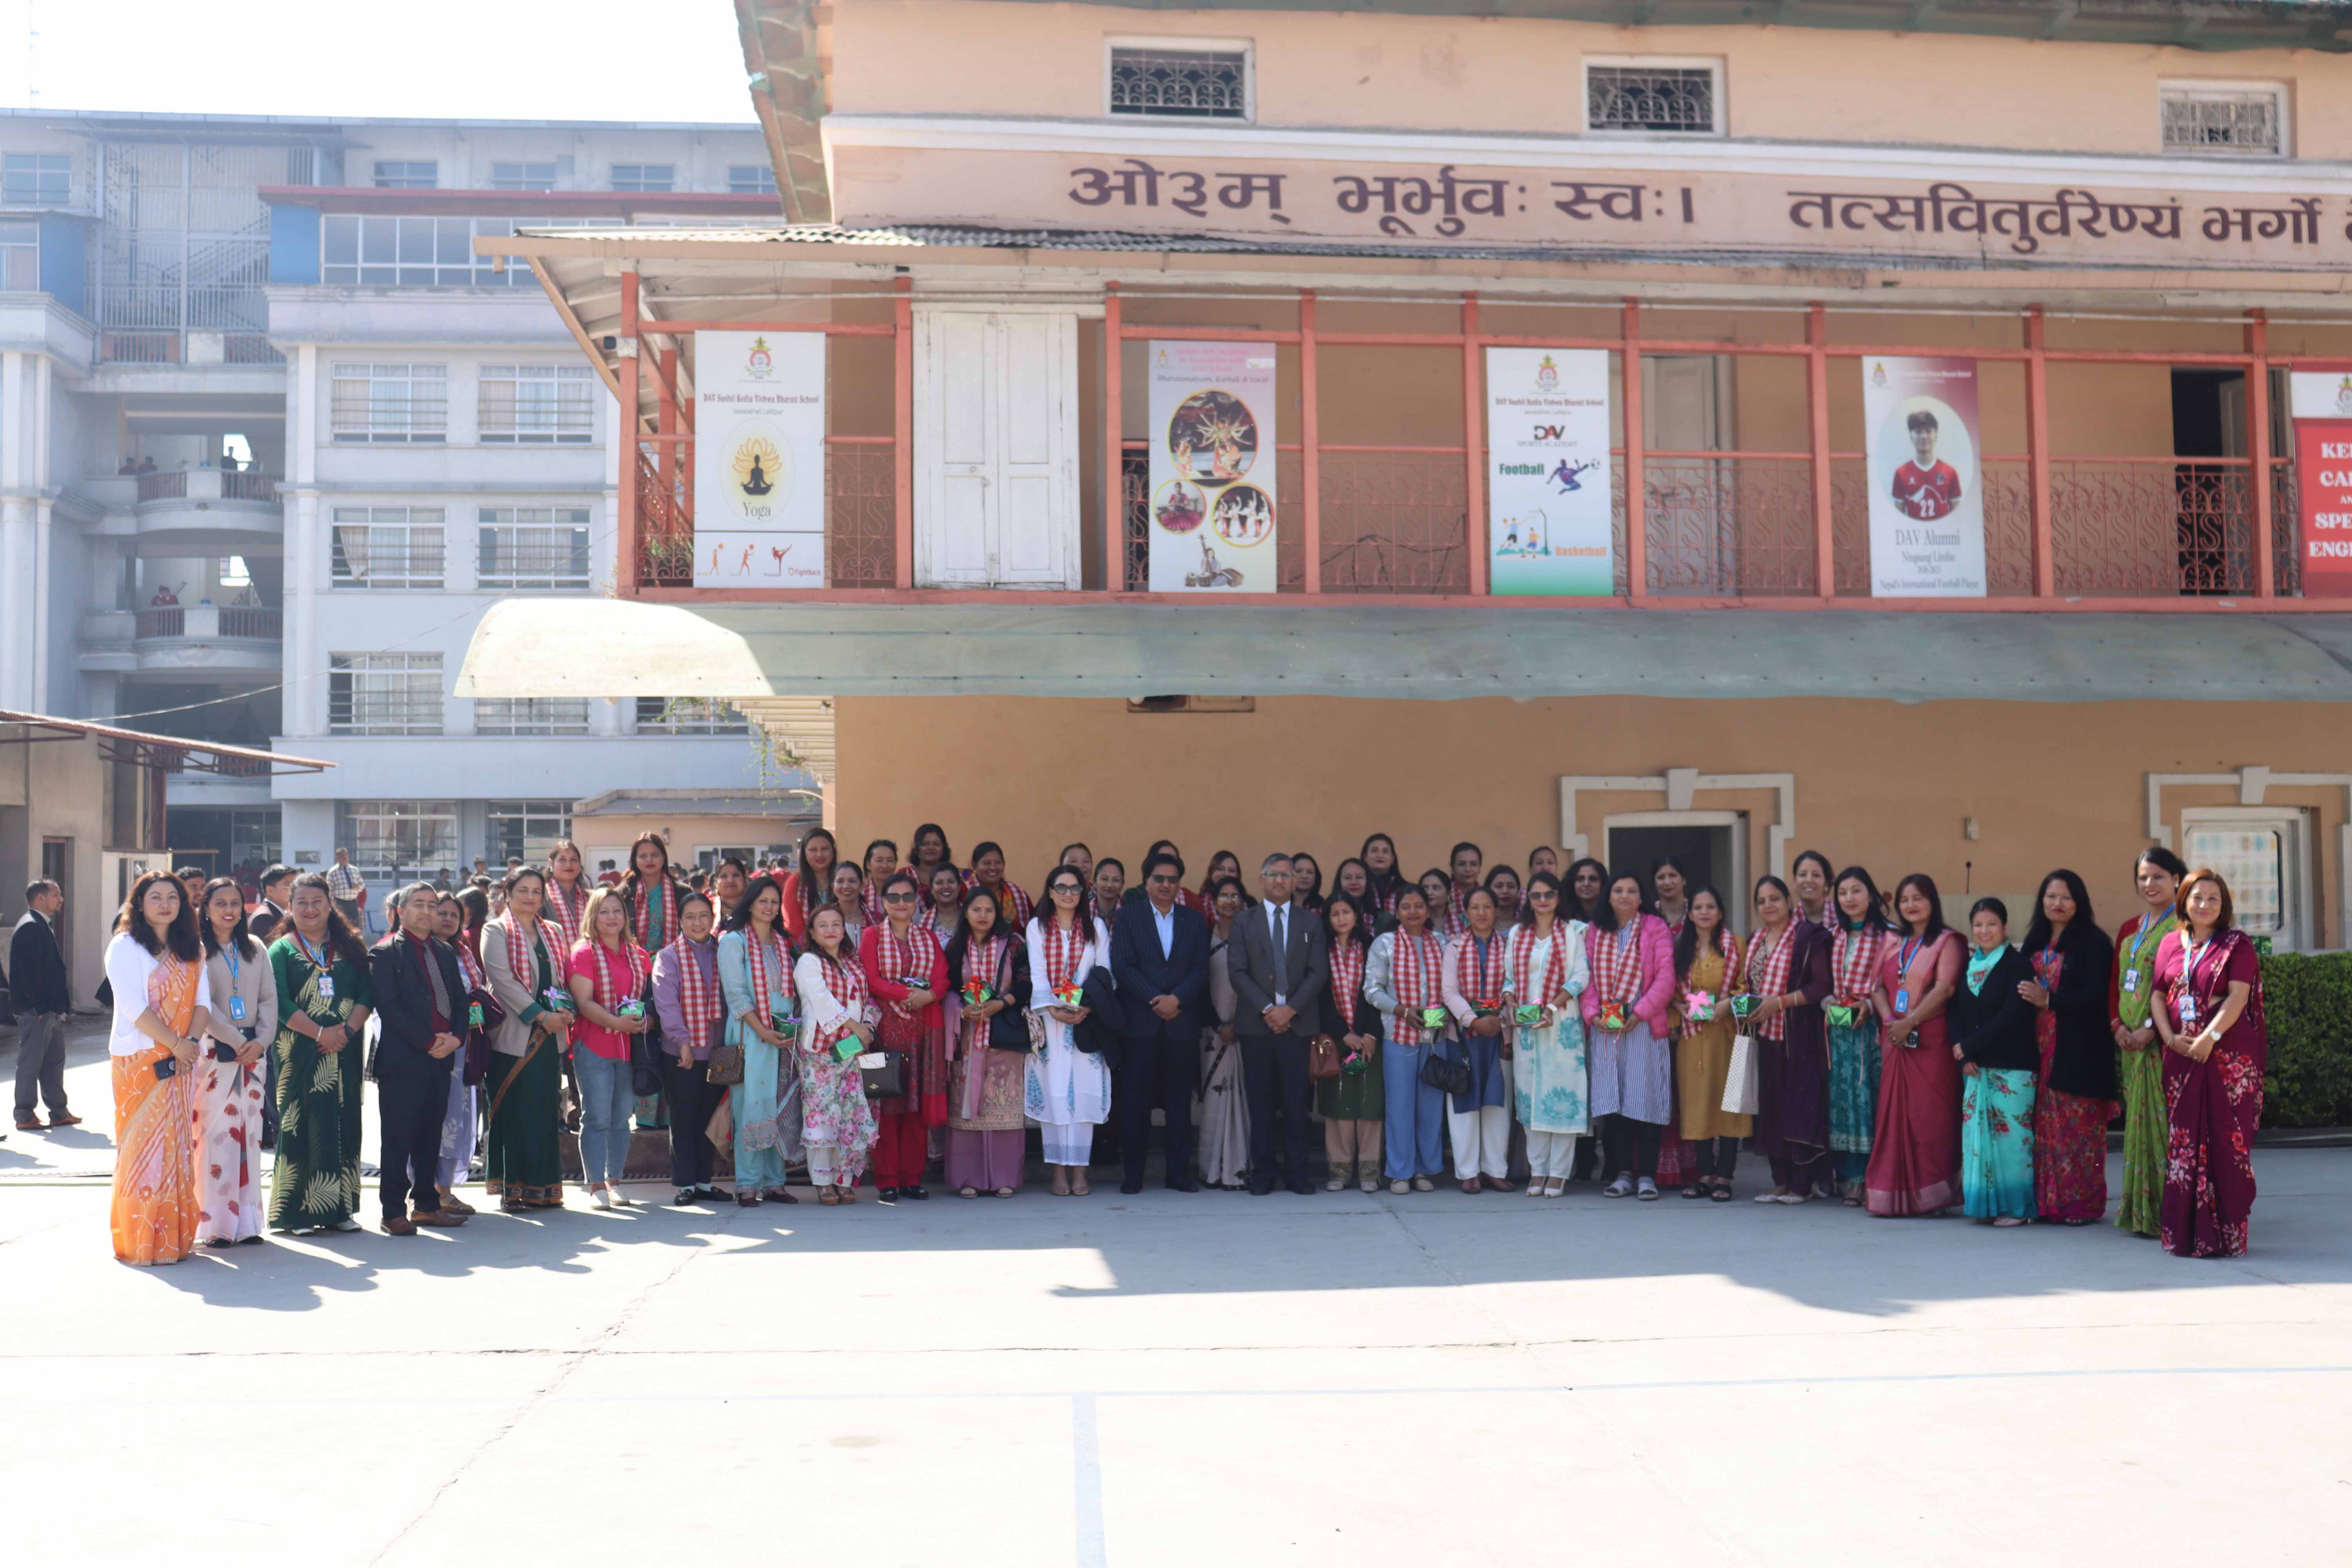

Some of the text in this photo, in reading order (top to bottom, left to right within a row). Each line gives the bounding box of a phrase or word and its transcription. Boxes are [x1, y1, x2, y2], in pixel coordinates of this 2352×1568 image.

[1069, 160, 1291, 225] ओ३म्
[1334, 165, 1527, 237] भूर्भुवः
[1788, 183, 2183, 254] तत्सवितुर्वरेण्यं
[2202, 198, 2323, 244] भर्गो
[799, 395, 819, 404] School
[2321, 442, 2352, 458] KE
[1499, 463, 1544, 475] Football
[2319, 470, 2352, 487] CA
[742, 502, 771, 521] Yoga
[1919, 499, 1935, 517] 22
[1895, 529, 1960, 546] DAV Alumni
[1555, 546, 1607, 557] Basketball
[2309, 541, 2352, 557] ENG
[795, 568, 821, 577] Fightback
[1901, 579, 1936, 589] International
[1938, 579, 1960, 589] Football
[1962, 579, 1979, 590] Player
